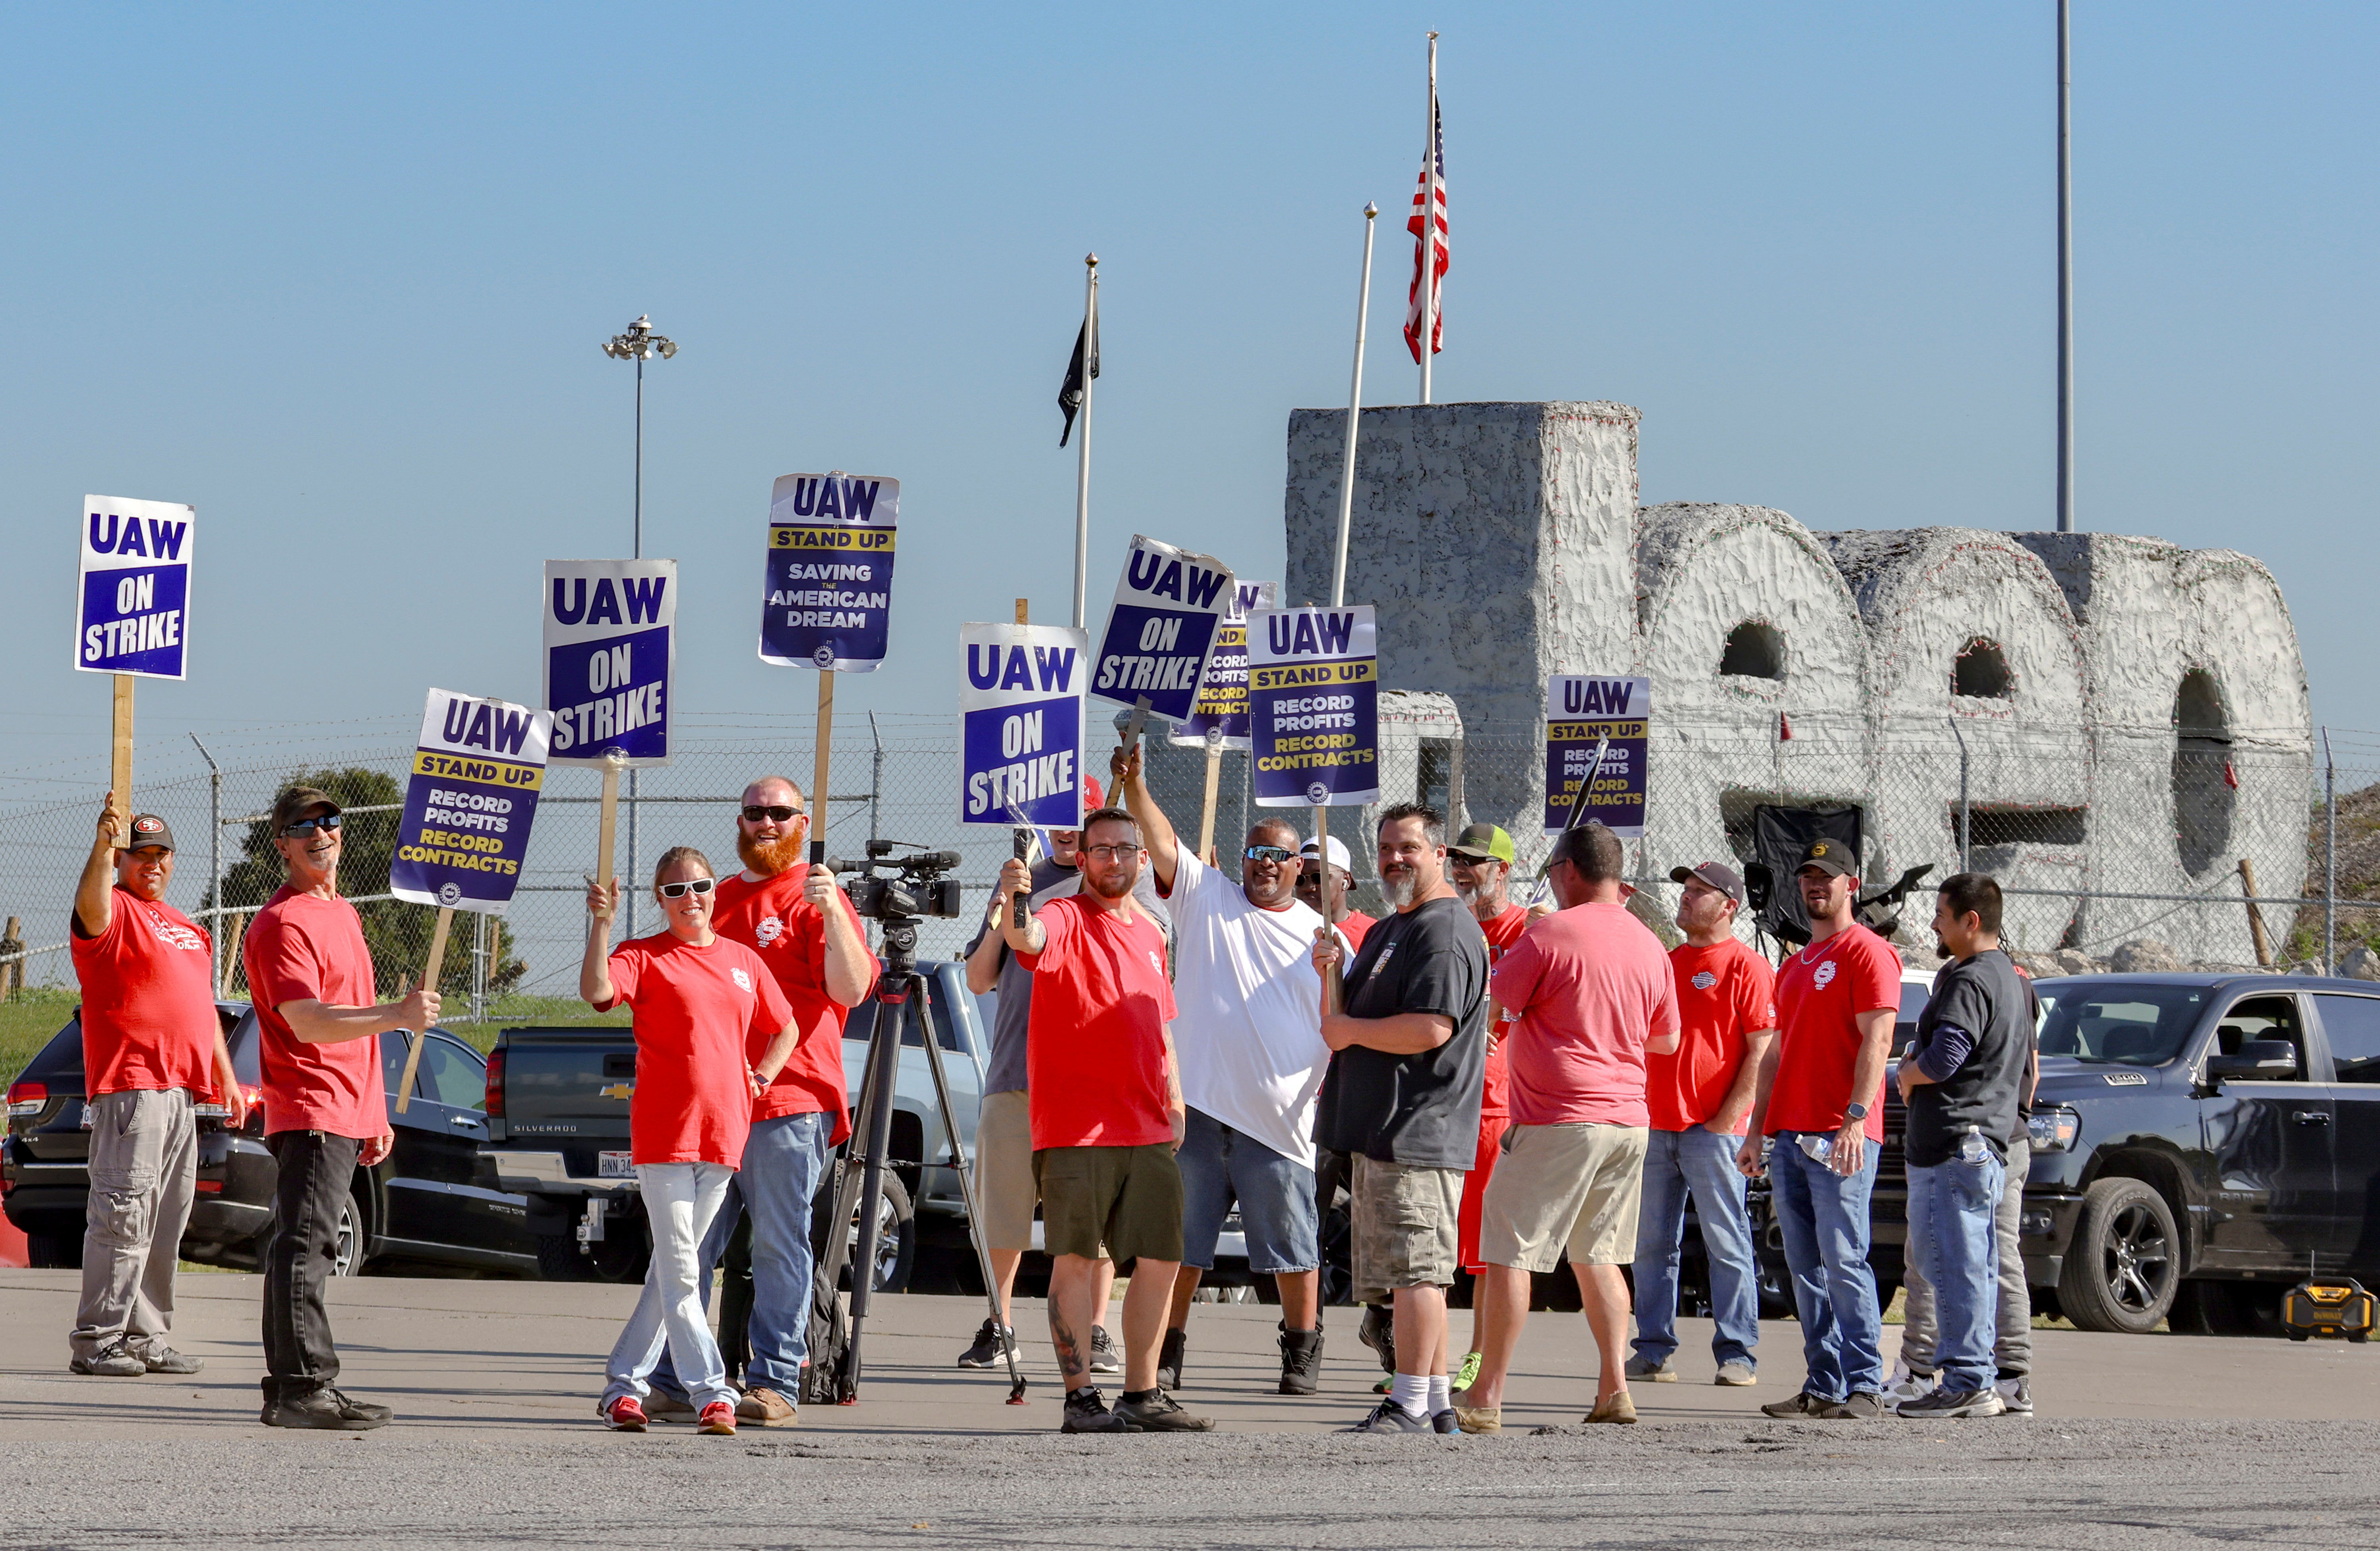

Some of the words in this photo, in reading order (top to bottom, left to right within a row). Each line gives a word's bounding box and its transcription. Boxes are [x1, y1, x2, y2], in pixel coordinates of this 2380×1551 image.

[793, 477, 880, 522] UAW
[90, 513, 187, 560] UAW
[777, 531, 851, 547] STAND
[859, 533, 888, 548] UP
[788, 563, 872, 582] SAVING
[1128, 549, 1227, 609] UAW
[116, 573, 154, 615] ON
[553, 577, 667, 625] UAW
[769, 589, 887, 609] AMERICAN
[787, 610, 866, 629] DREAM
[85, 609, 180, 662] STRIKE
[1139, 617, 1183, 651] ON
[1269, 612, 1354, 655] UAW
[589, 642, 631, 694] ON
[968, 643, 1077, 693] UAW
[1098, 655, 1200, 690] STRIKE
[1209, 655, 1248, 668] CORD
[1205, 669, 1249, 683] ROFITS
[1257, 667, 1332, 687] STAND
[1339, 664, 1368, 680] UP
[1199, 687, 1247, 700] ECORD
[1273, 695, 1355, 715] RECORD
[1564, 680, 1633, 714] UAW
[554, 680, 662, 750] STRIKE
[1194, 701, 1250, 714] NTRACT
[443, 698, 534, 755] UAW
[1002, 709, 1043, 759] ON
[1274, 712, 1356, 733] PROFITS
[1553, 725, 1612, 738] STAND
[1618, 724, 1642, 737] UP
[1274, 733, 1356, 754] RECORD
[421, 756, 497, 780] STAND
[505, 767, 536, 785] UP
[1257, 748, 1374, 772] CONTRACTS
[969, 749, 1074, 816] STRIKE
[1564, 779, 1628, 792] REORD
[428, 789, 512, 814] RECORD
[424, 807, 509, 833] PROFITS
[419, 829, 503, 854] RECORD
[398, 845, 518, 875] CONTRACTS
[897, 898, 911, 907] SONY
[602, 1159, 618, 1173] HNN
[2219, 1192, 2254, 1202] RAM
